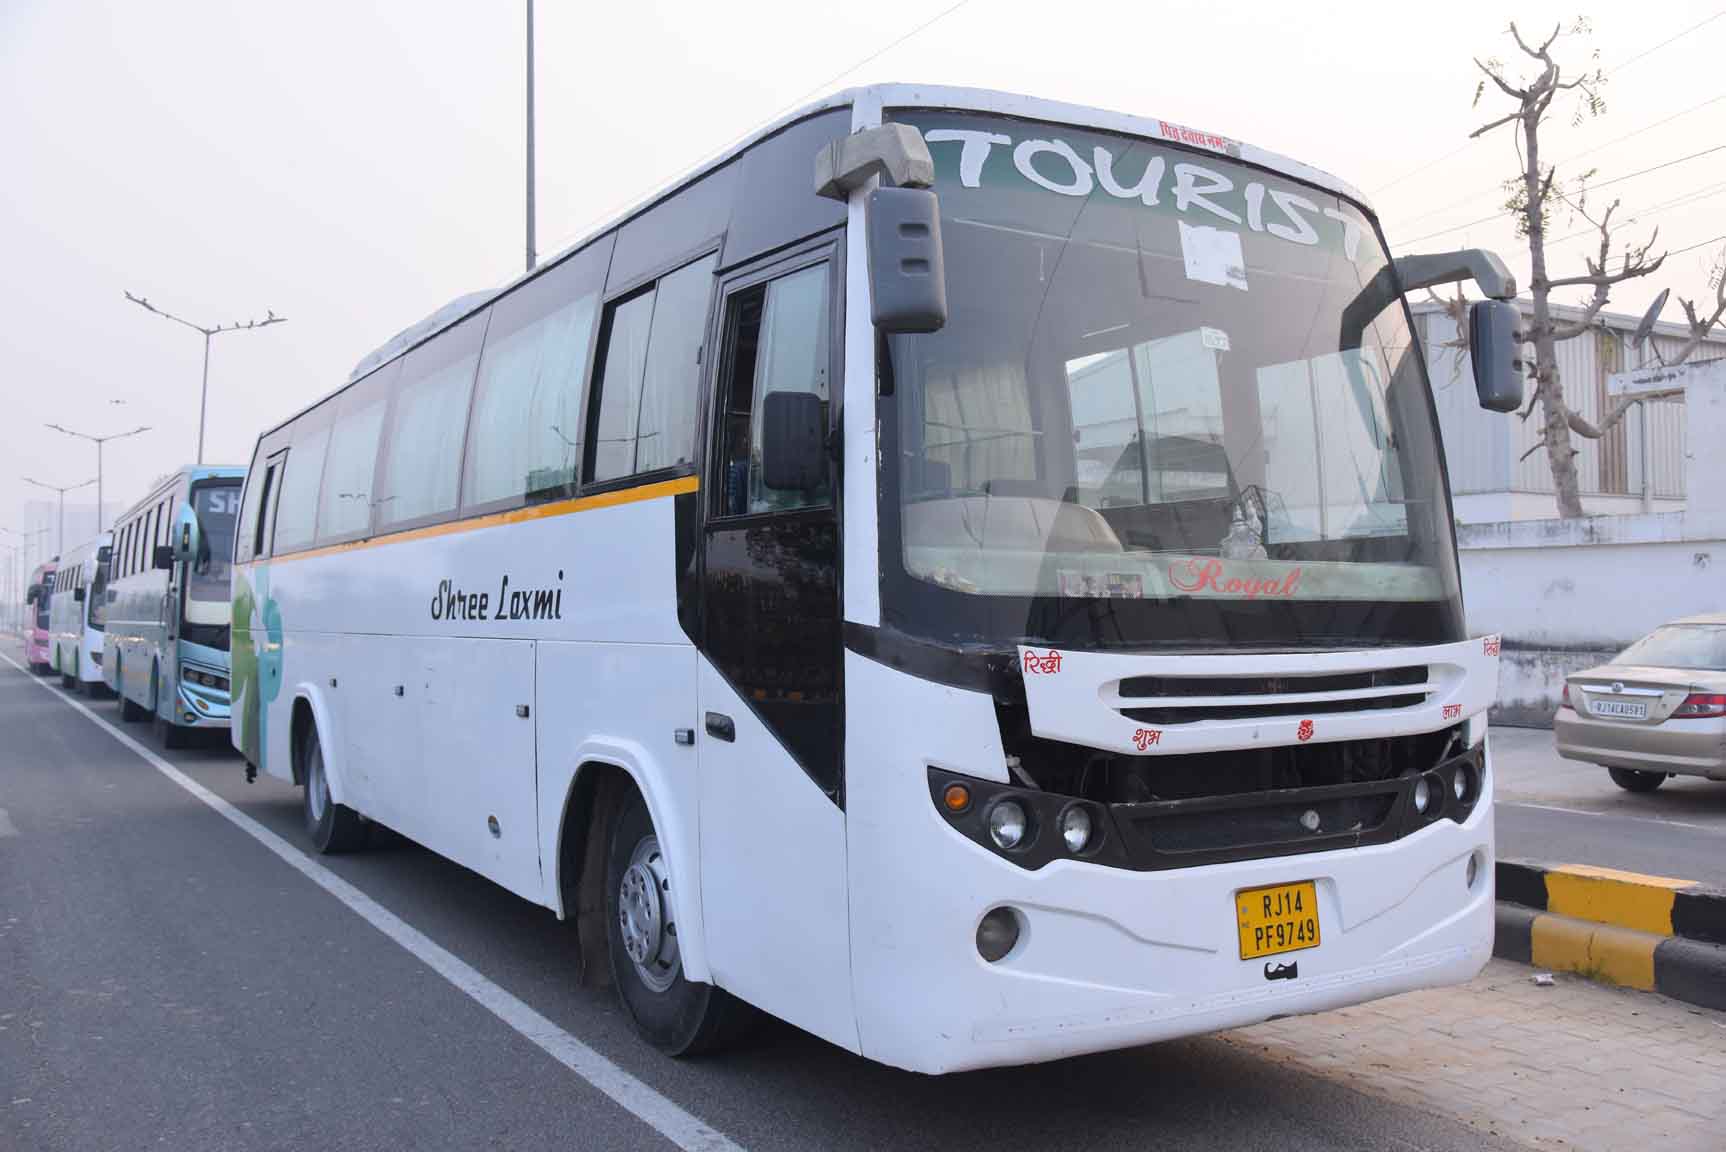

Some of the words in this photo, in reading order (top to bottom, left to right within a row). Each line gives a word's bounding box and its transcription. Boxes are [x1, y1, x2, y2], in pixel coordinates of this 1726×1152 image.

[925, 128, 1371, 261] TOURIST
[431, 578, 489, 620] Shree
[494, 569, 564, 620] Laxmi
[1168, 556, 1301, 600] Royal
[1442, 703, 1463, 720] लाभ
[1132, 728, 1163, 751] शुभ
[1262, 889, 1304, 919] RJ14
[1255, 918, 1316, 951] PF9749
